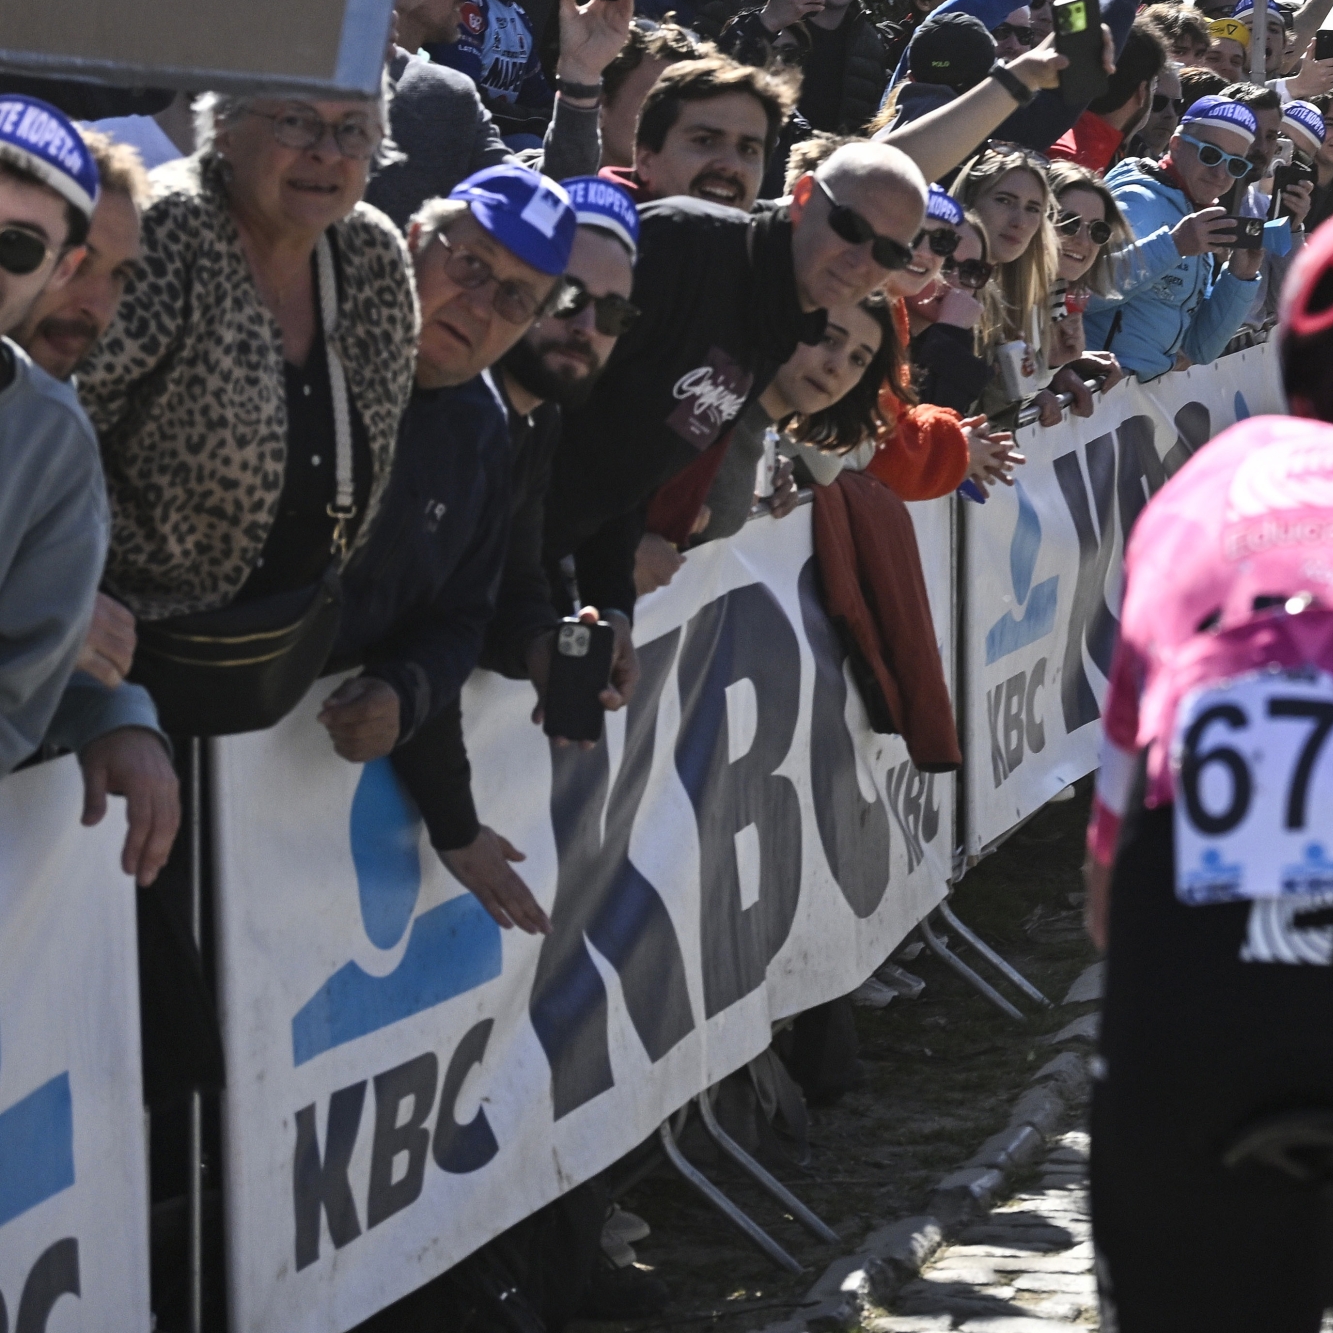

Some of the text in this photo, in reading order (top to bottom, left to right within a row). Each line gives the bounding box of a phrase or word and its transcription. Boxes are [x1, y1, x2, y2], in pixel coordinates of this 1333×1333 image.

[1209, 103, 1232, 117] LOTTE
[1288, 106, 1307, 122] LOTTE
[986, 657, 1048, 789] KBC
[529, 555, 891, 1123] KBC
[294, 1018, 499, 1272] KBC
